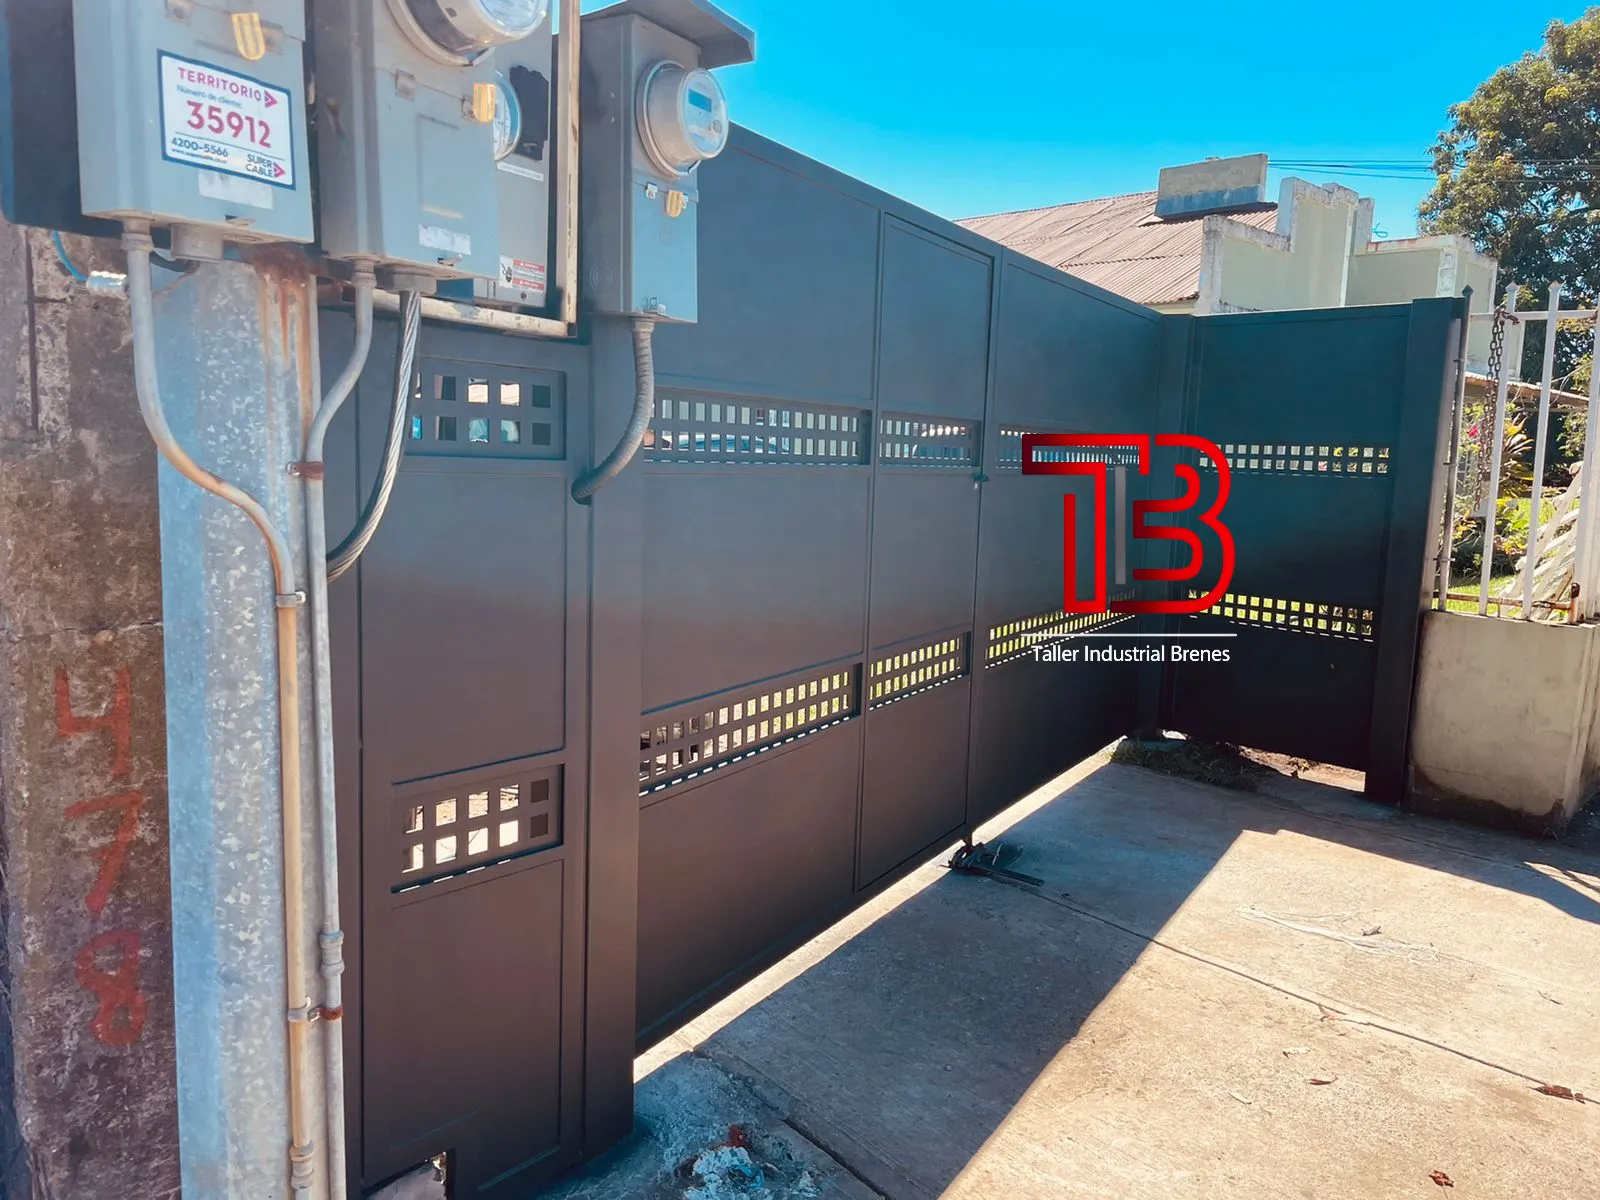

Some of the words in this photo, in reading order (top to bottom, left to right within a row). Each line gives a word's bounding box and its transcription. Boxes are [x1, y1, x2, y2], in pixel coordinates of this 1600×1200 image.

[177, 67, 262, 102] TERRITORIO
[186, 99, 272, 148] 35912
[171, 137, 229, 158] 4200-5566
[245, 163, 273, 178] CABLE
[247, 153, 273, 168] SUPER
